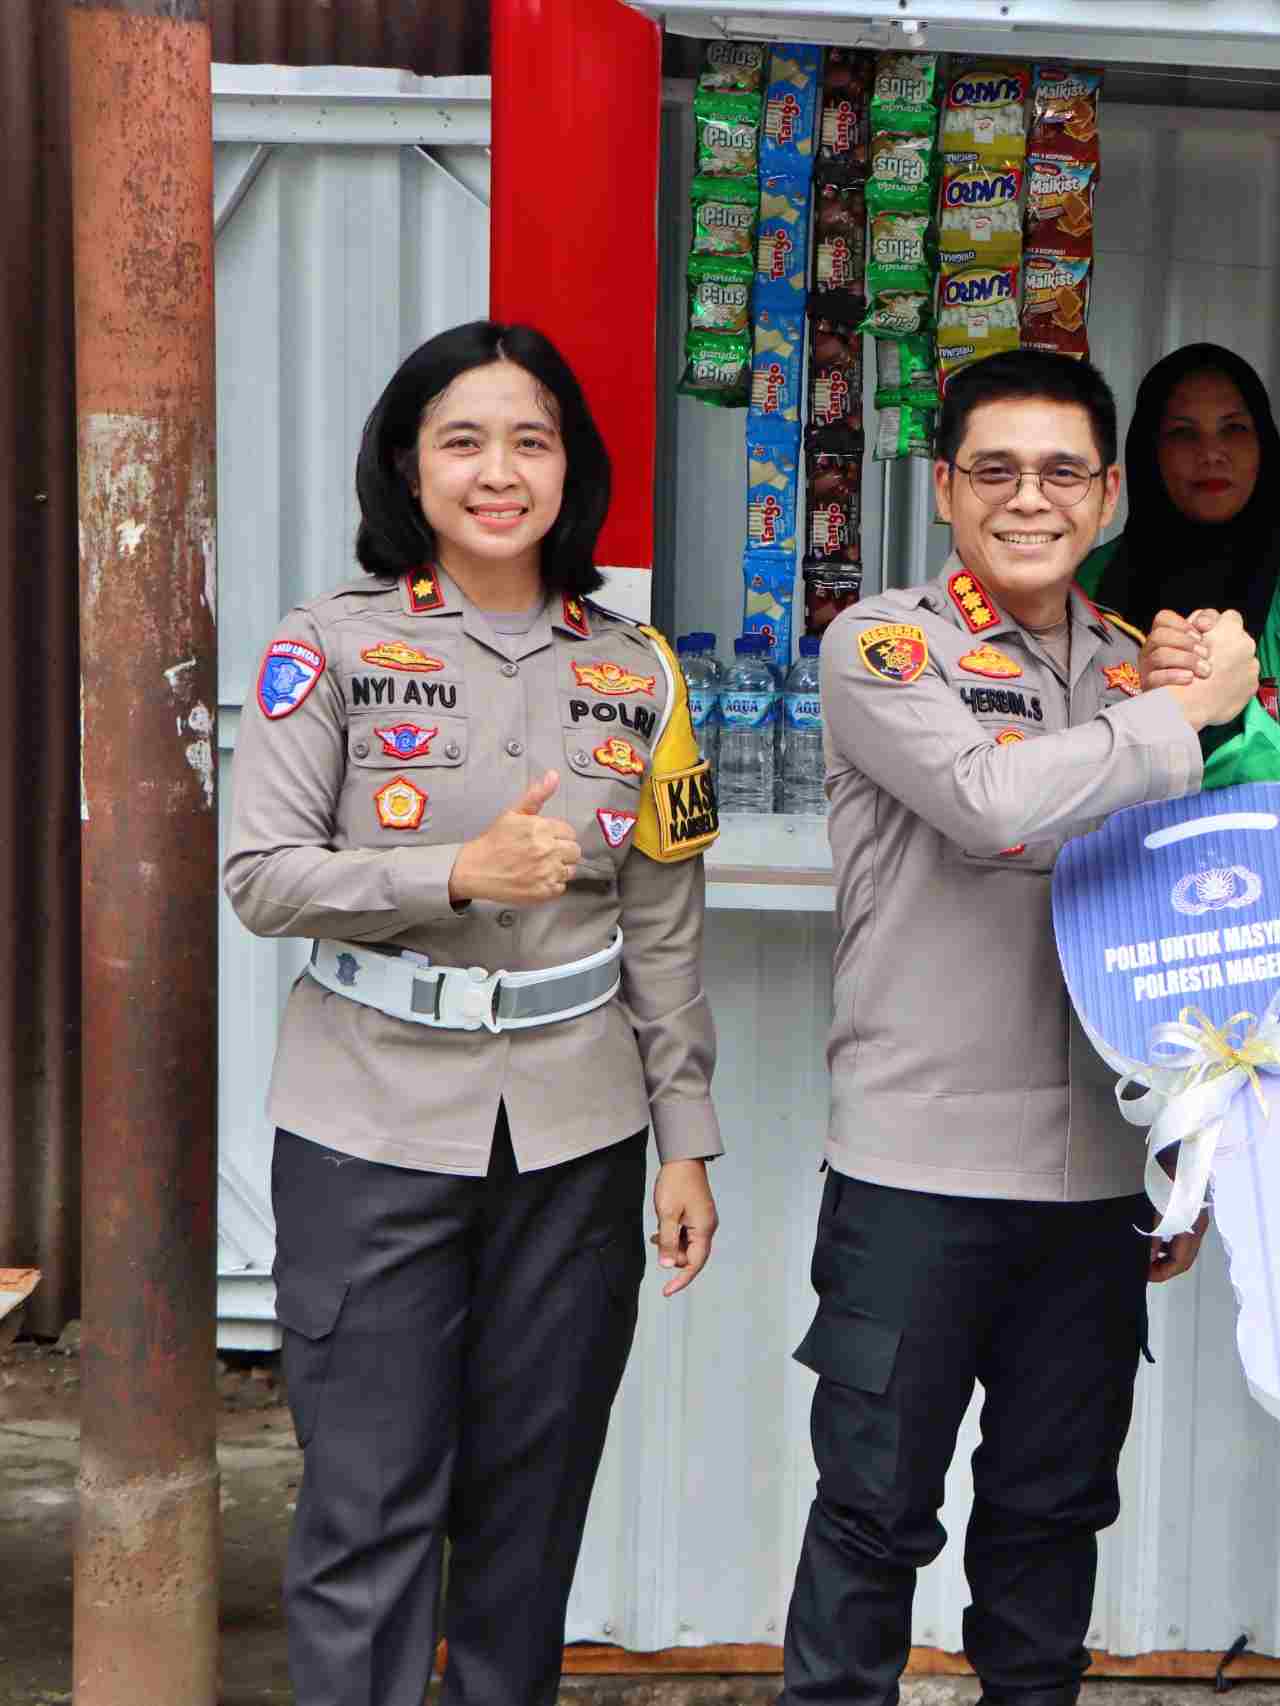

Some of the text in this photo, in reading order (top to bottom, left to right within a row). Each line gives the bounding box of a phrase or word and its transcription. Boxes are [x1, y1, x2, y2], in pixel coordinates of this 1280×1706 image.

[777, 94, 800, 145] Tango
[833, 102, 858, 154] Tango
[770, 229, 792, 281] Tango
[827, 237, 850, 290] Tango
[701, 285, 746, 305] Pilus
[762, 362, 785, 414] Tango
[824, 371, 849, 424] Tango
[760, 495, 783, 544] Tango
[823, 503, 846, 556] Tango
[351, 676, 457, 709] NYI AYU
[725, 701, 759, 713] AQUA
[794, 701, 821, 714] AQU
[1103, 940, 1158, 974] POLRI
[1161, 929, 1221, 964] UNTUK
[1133, 962, 1224, 1003] POLRESTA
